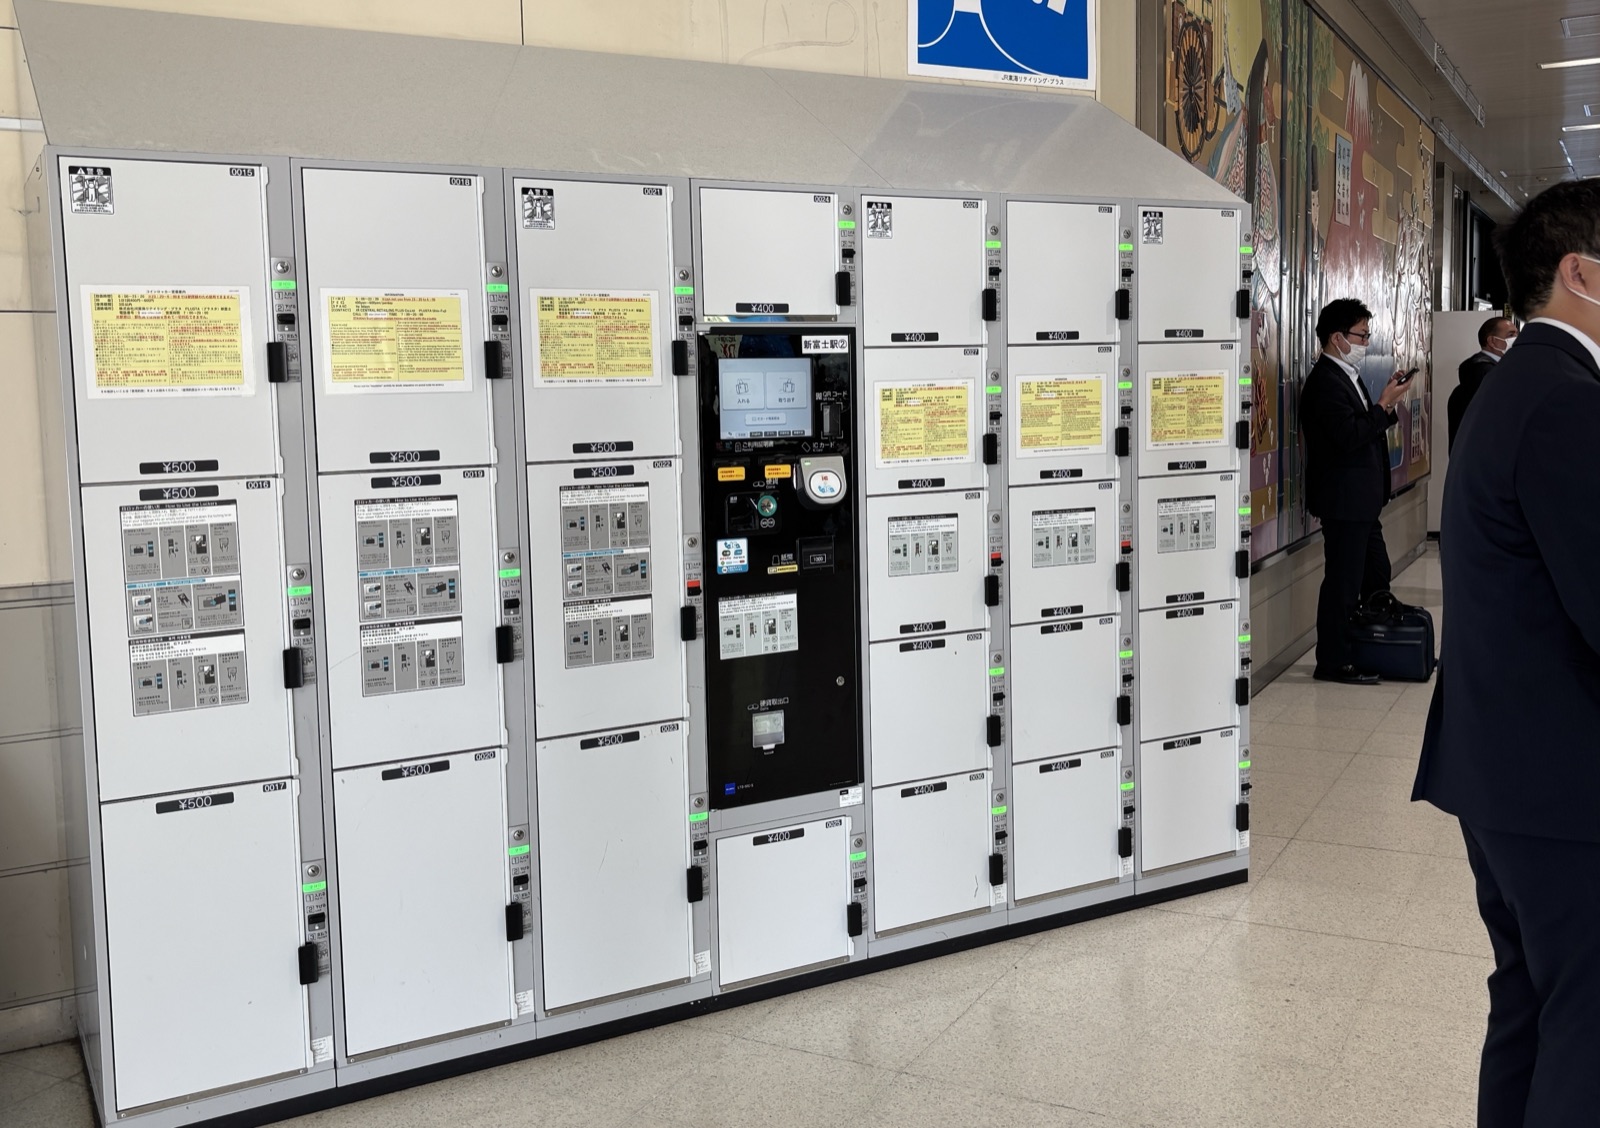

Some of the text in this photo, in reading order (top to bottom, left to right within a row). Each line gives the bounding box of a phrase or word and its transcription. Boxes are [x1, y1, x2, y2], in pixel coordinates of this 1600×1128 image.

[1001, 75, 1064, 85] JR東海リテイリング・プラス
[231, 168, 254, 176] 0015
[751, 304, 774, 313] ¥400
[1048, 332, 1067, 340] ¥400
[803, 338, 847, 349] 新富士駅②
[591, 442, 616, 452] ¥500
[390, 452, 420, 462] ¥500
[163, 461, 196, 473] ¥500
[591, 466, 617, 477] ¥500
[1052, 470, 1071, 478] ¥400
[247, 481, 269, 489] 0016
[392, 476, 421, 487] ¥500
[912, 479, 932, 487] ¥400
[163, 488, 196, 499] ¥500
[1177, 593, 1194, 602] ¥400
[1053, 607, 1071, 615] ¥400
[1177, 609, 1193, 618] ¥400
[913, 622, 933, 632] ¥400
[1053, 623, 1071, 632] ¥400
[913, 640, 933, 650] ¥400
[661, 724, 678, 732] 0023
[598, 734, 623, 747] ¥500
[1174, 739, 1190, 748] ¥400
[476, 752, 495, 760] 0020
[402, 764, 430, 777] ¥500
[1052, 761, 1070, 771] ¥400
[264, 783, 286, 791] 0017
[915, 784, 934, 795] ¥400
[179, 796, 212, 810] ¥500
[768, 831, 790, 842] ¥400
